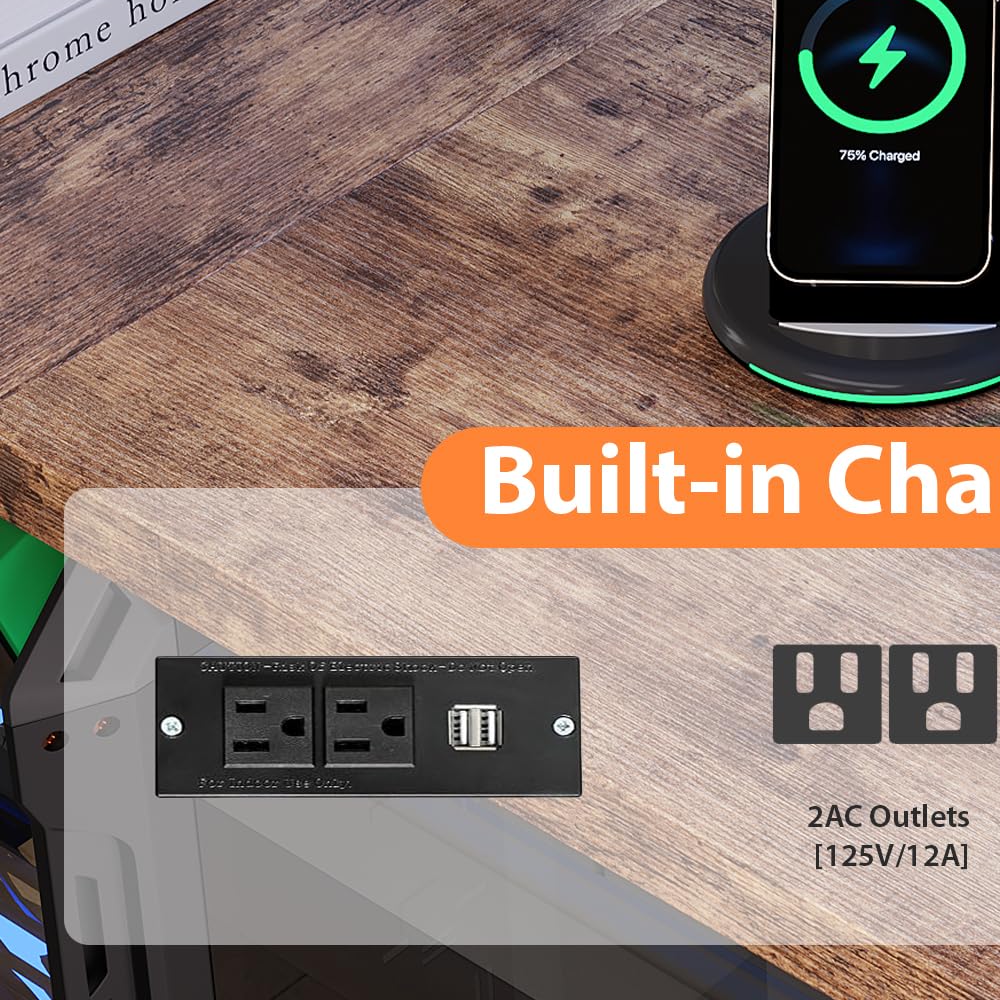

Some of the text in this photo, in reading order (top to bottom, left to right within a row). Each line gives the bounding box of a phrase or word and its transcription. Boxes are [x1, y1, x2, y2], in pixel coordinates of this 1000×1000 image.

[1, 21, 112, 97] hrome
[839, 149, 921, 164] 75% Charged
